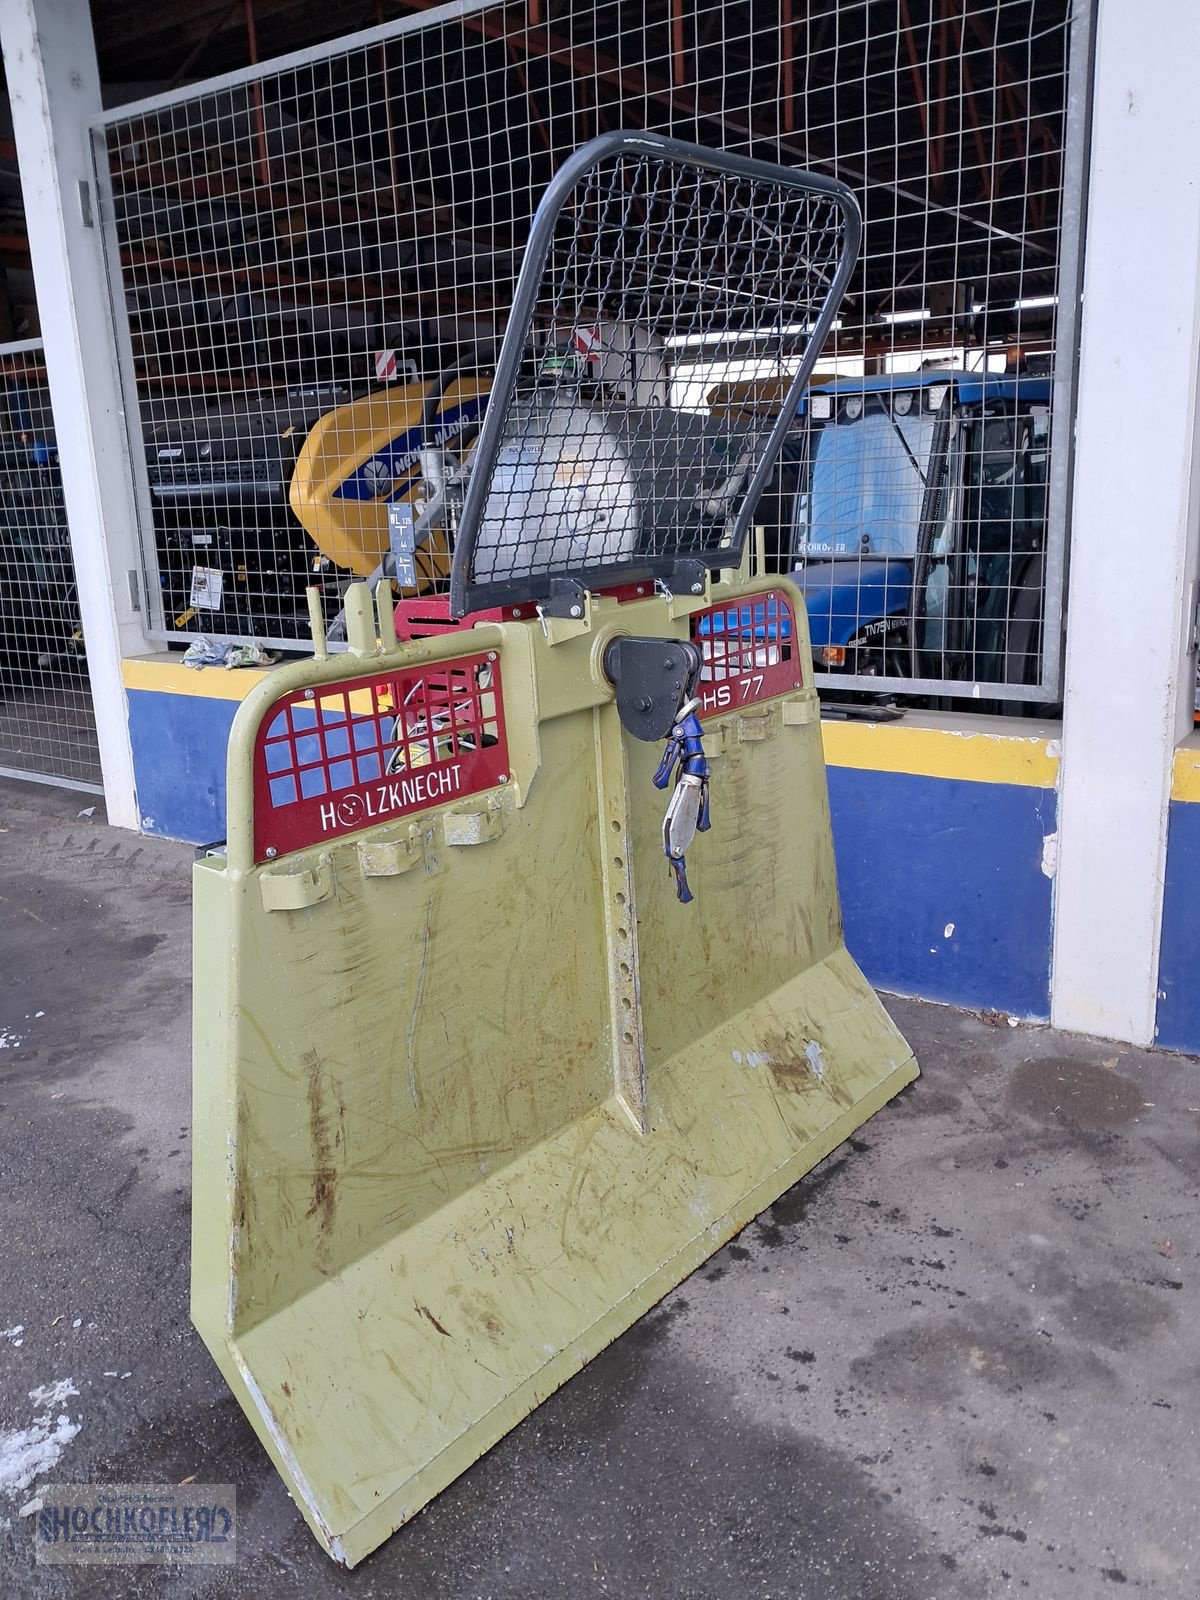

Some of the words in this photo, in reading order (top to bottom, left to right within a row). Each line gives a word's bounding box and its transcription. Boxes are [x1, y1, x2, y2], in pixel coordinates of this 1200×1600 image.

[703, 685, 731, 711] HS
[740, 674, 764, 699] 77
[320, 764, 461, 831] HOLZKNECHT
